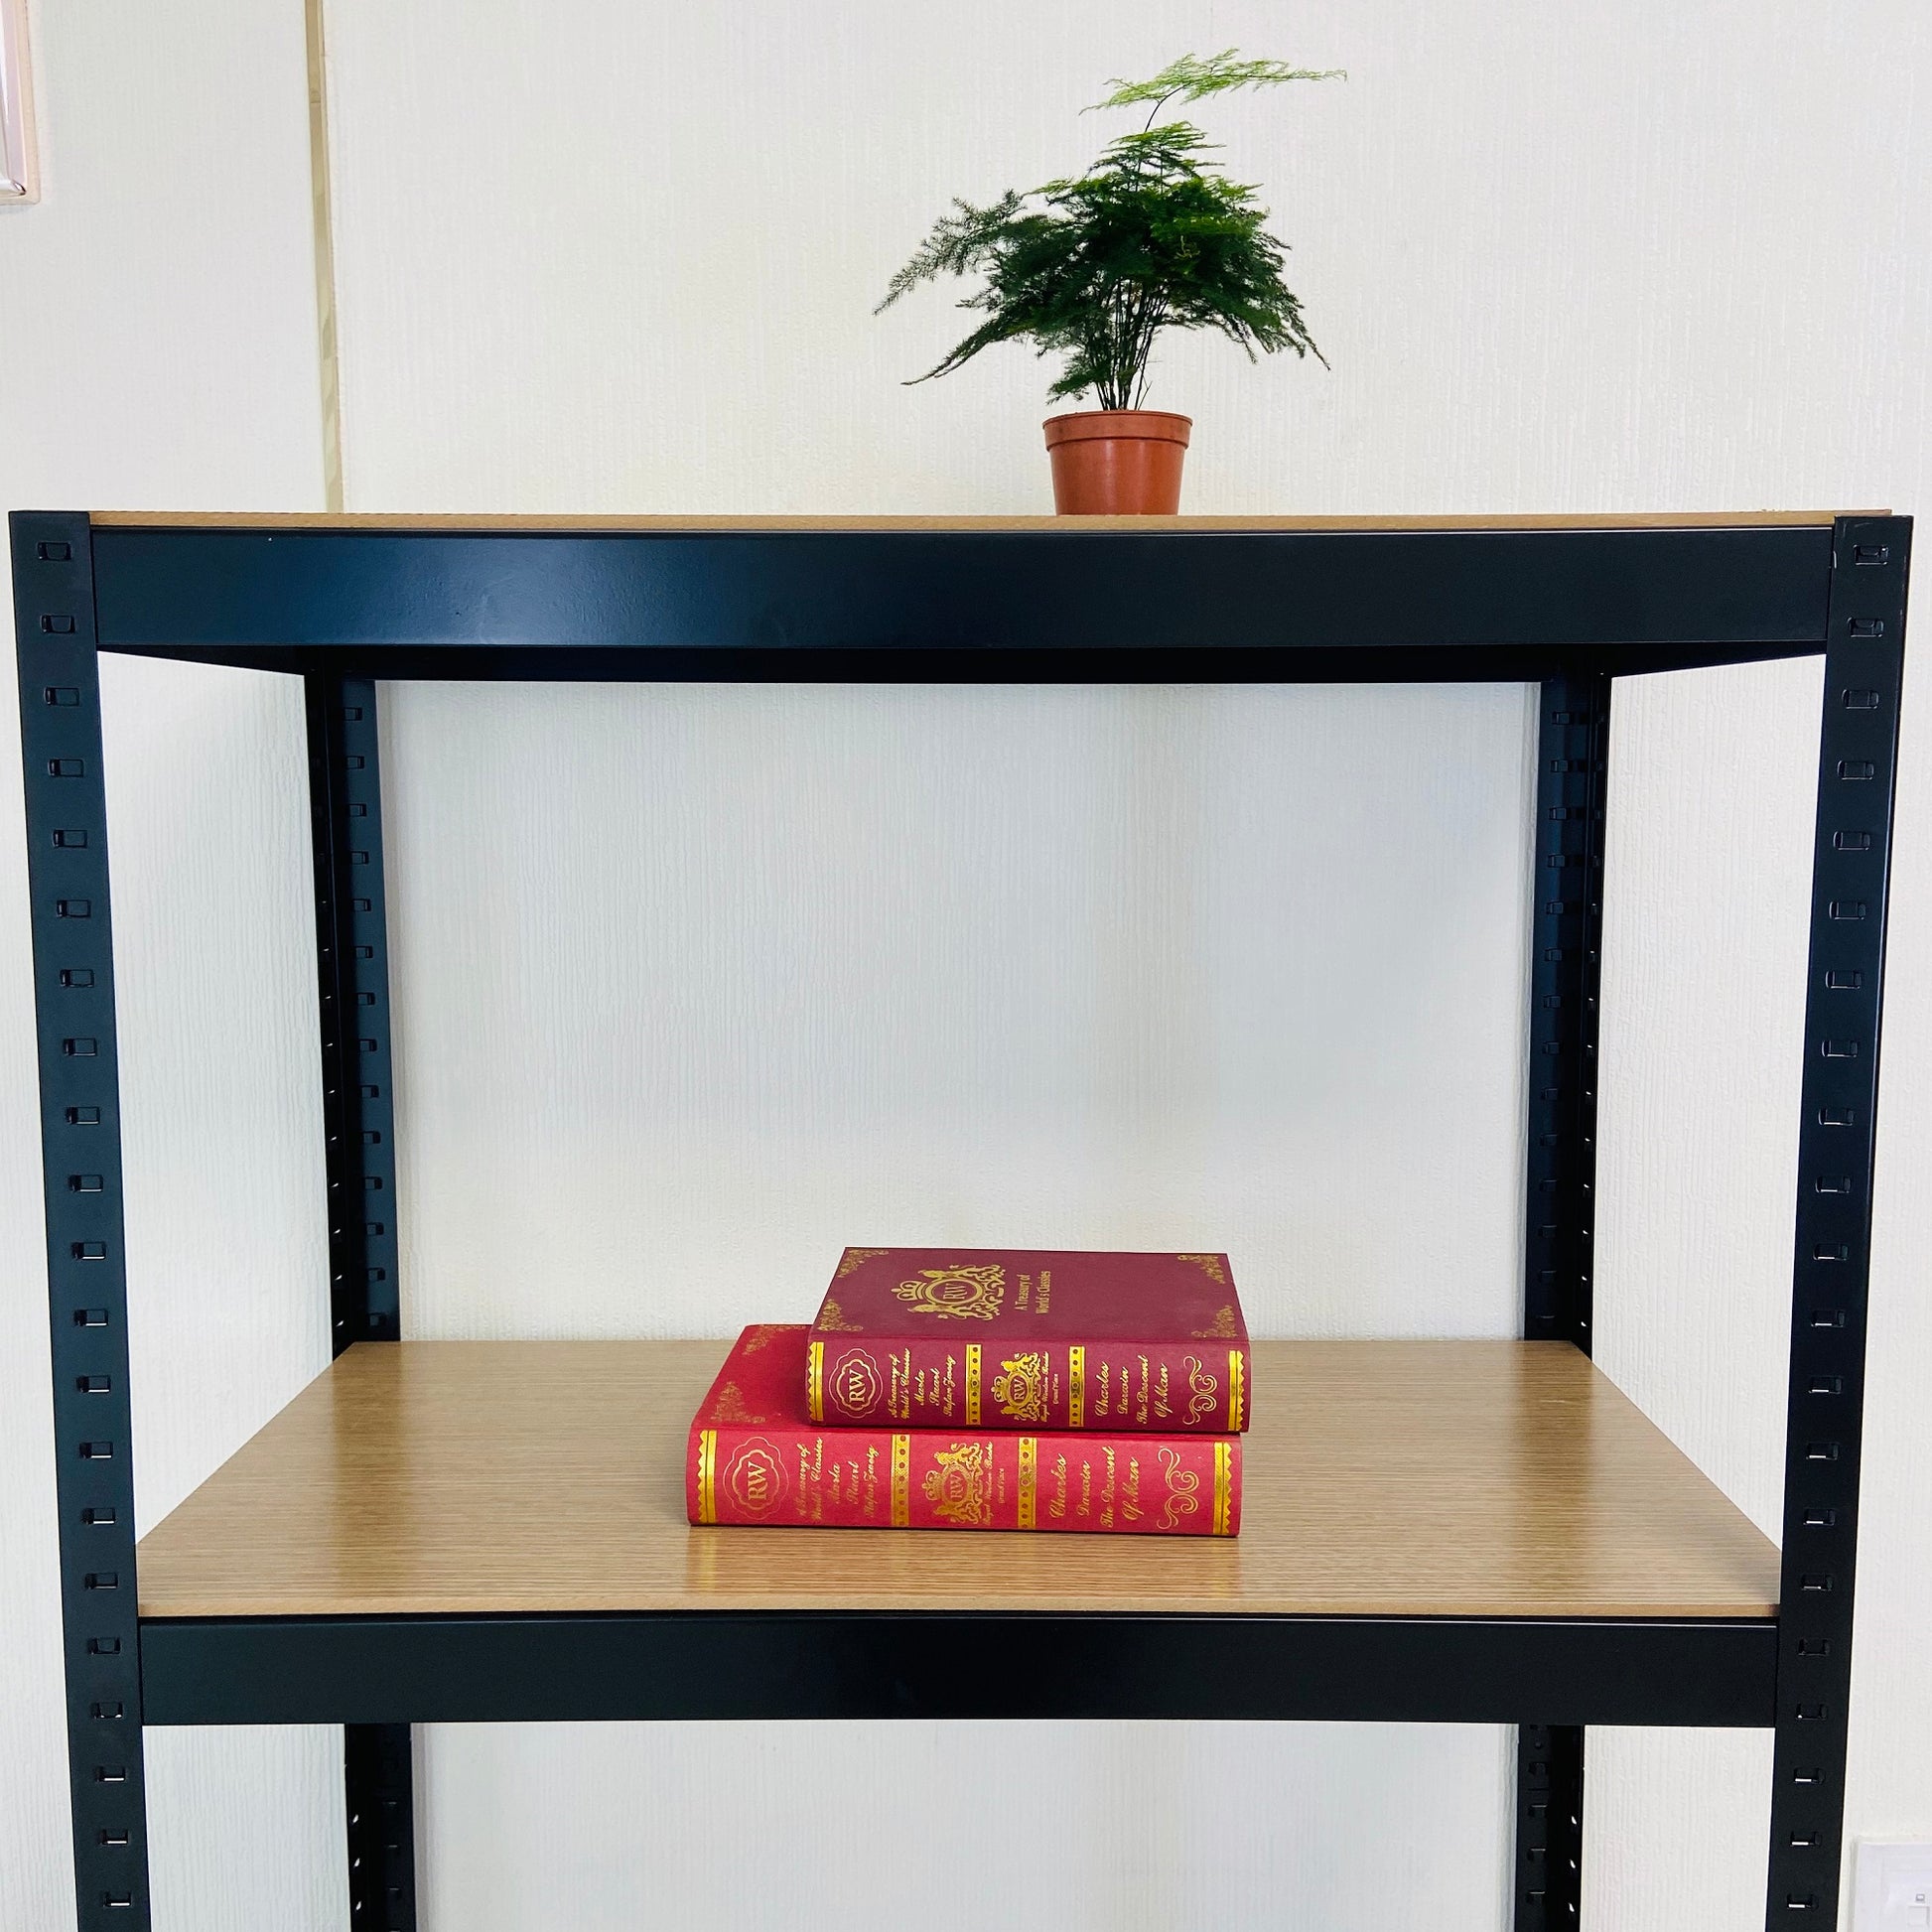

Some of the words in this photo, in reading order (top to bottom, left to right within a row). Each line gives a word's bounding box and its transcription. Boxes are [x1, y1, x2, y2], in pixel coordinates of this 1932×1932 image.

[943, 1282, 968, 1301] RW
[1015, 1281, 1034, 1306] Treasury
[1035, 1271, 1051, 1293] Classics
[1035, 1293, 1050, 1313] World's
[889, 1353, 901, 1366] of
[899, 1348, 910, 1387] Classics
[849, 1369, 866, 1403] RW
[888, 1366, 900, 1408] Treasury
[1014, 1379, 1027, 1400] RW
[1094, 1361, 1109, 1416] Charles
[1116, 1366, 1128, 1414] Darwin
[1136, 1354, 1149, 1403] Descent
[1154, 1362, 1169, 1402] Man
[1136, 1403, 1148, 1424] The
[1154, 1400, 1173, 1418] Of
[796, 1444, 811, 1457] of
[810, 1437, 823, 1482] Classics
[748, 1460, 767, 1500] RW
[796, 1458, 811, 1507] Treasury
[950, 1473, 964, 1499] RW
[1048, 1452, 1066, 1518] Charles
[1076, 1459, 1090, 1516] Darwin
[1101, 1446, 1115, 1503] Descent
[1122, 1456, 1139, 1502] Man
[1099, 1504, 1113, 1528] The
[1122, 1500, 1144, 1520] Of
